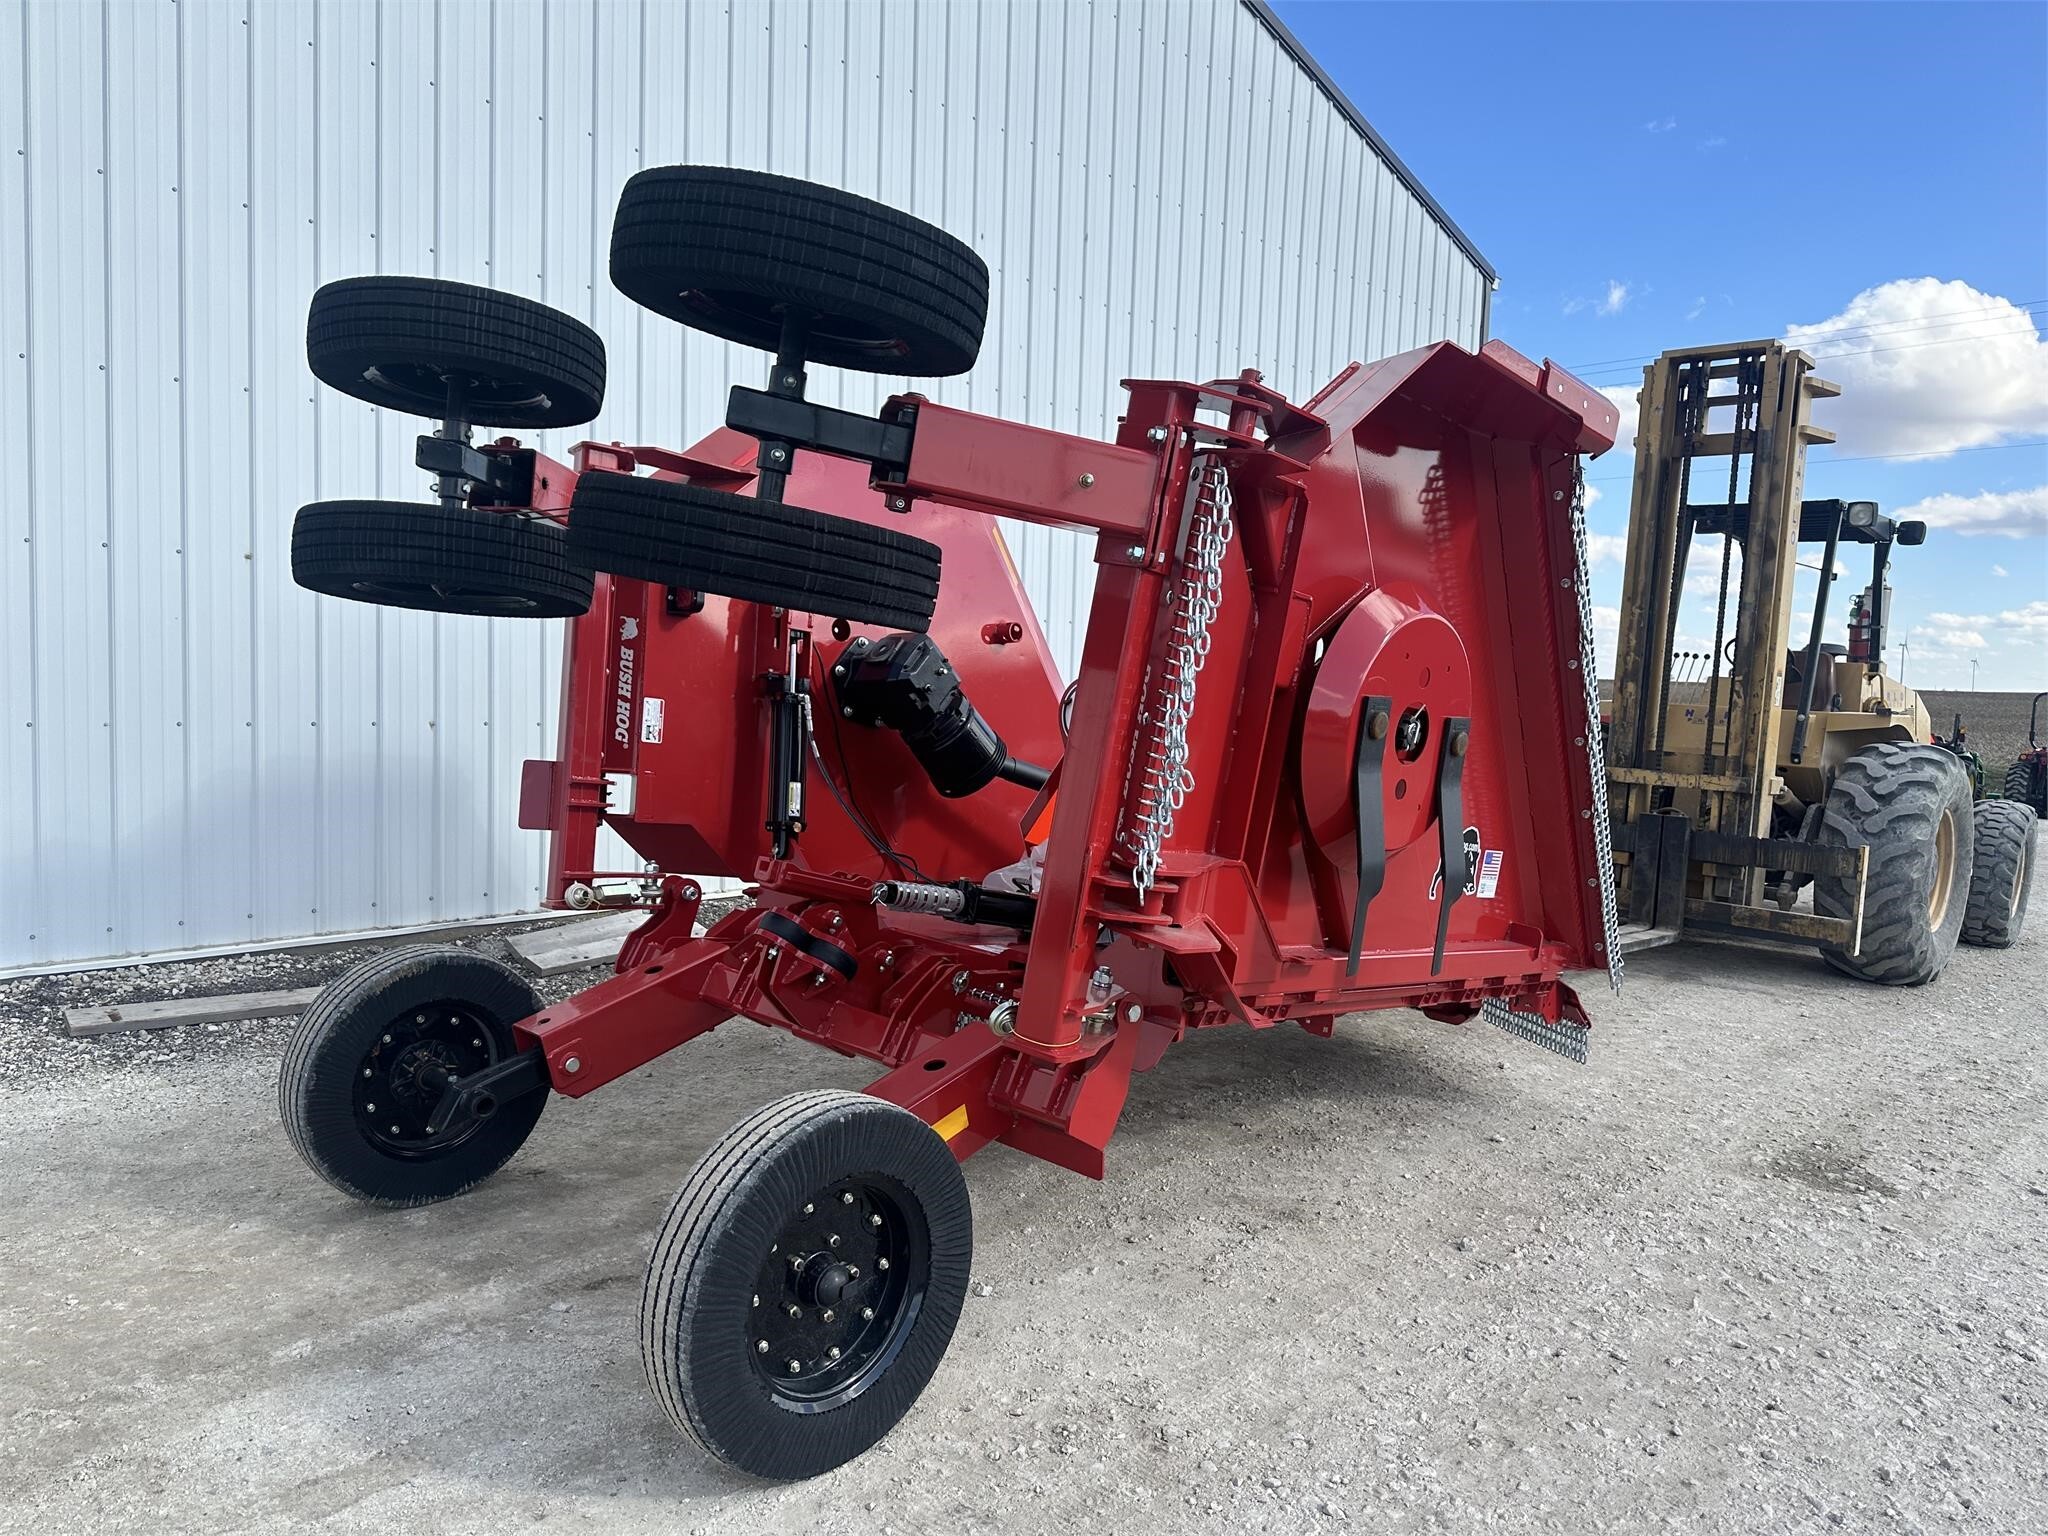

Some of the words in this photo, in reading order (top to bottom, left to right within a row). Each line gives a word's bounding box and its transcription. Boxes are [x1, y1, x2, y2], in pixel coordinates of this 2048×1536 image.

[1791, 444, 1804, 545] HARLO
[618, 646, 634, 698] BUSH
[615, 699, 631, 743] HOG
